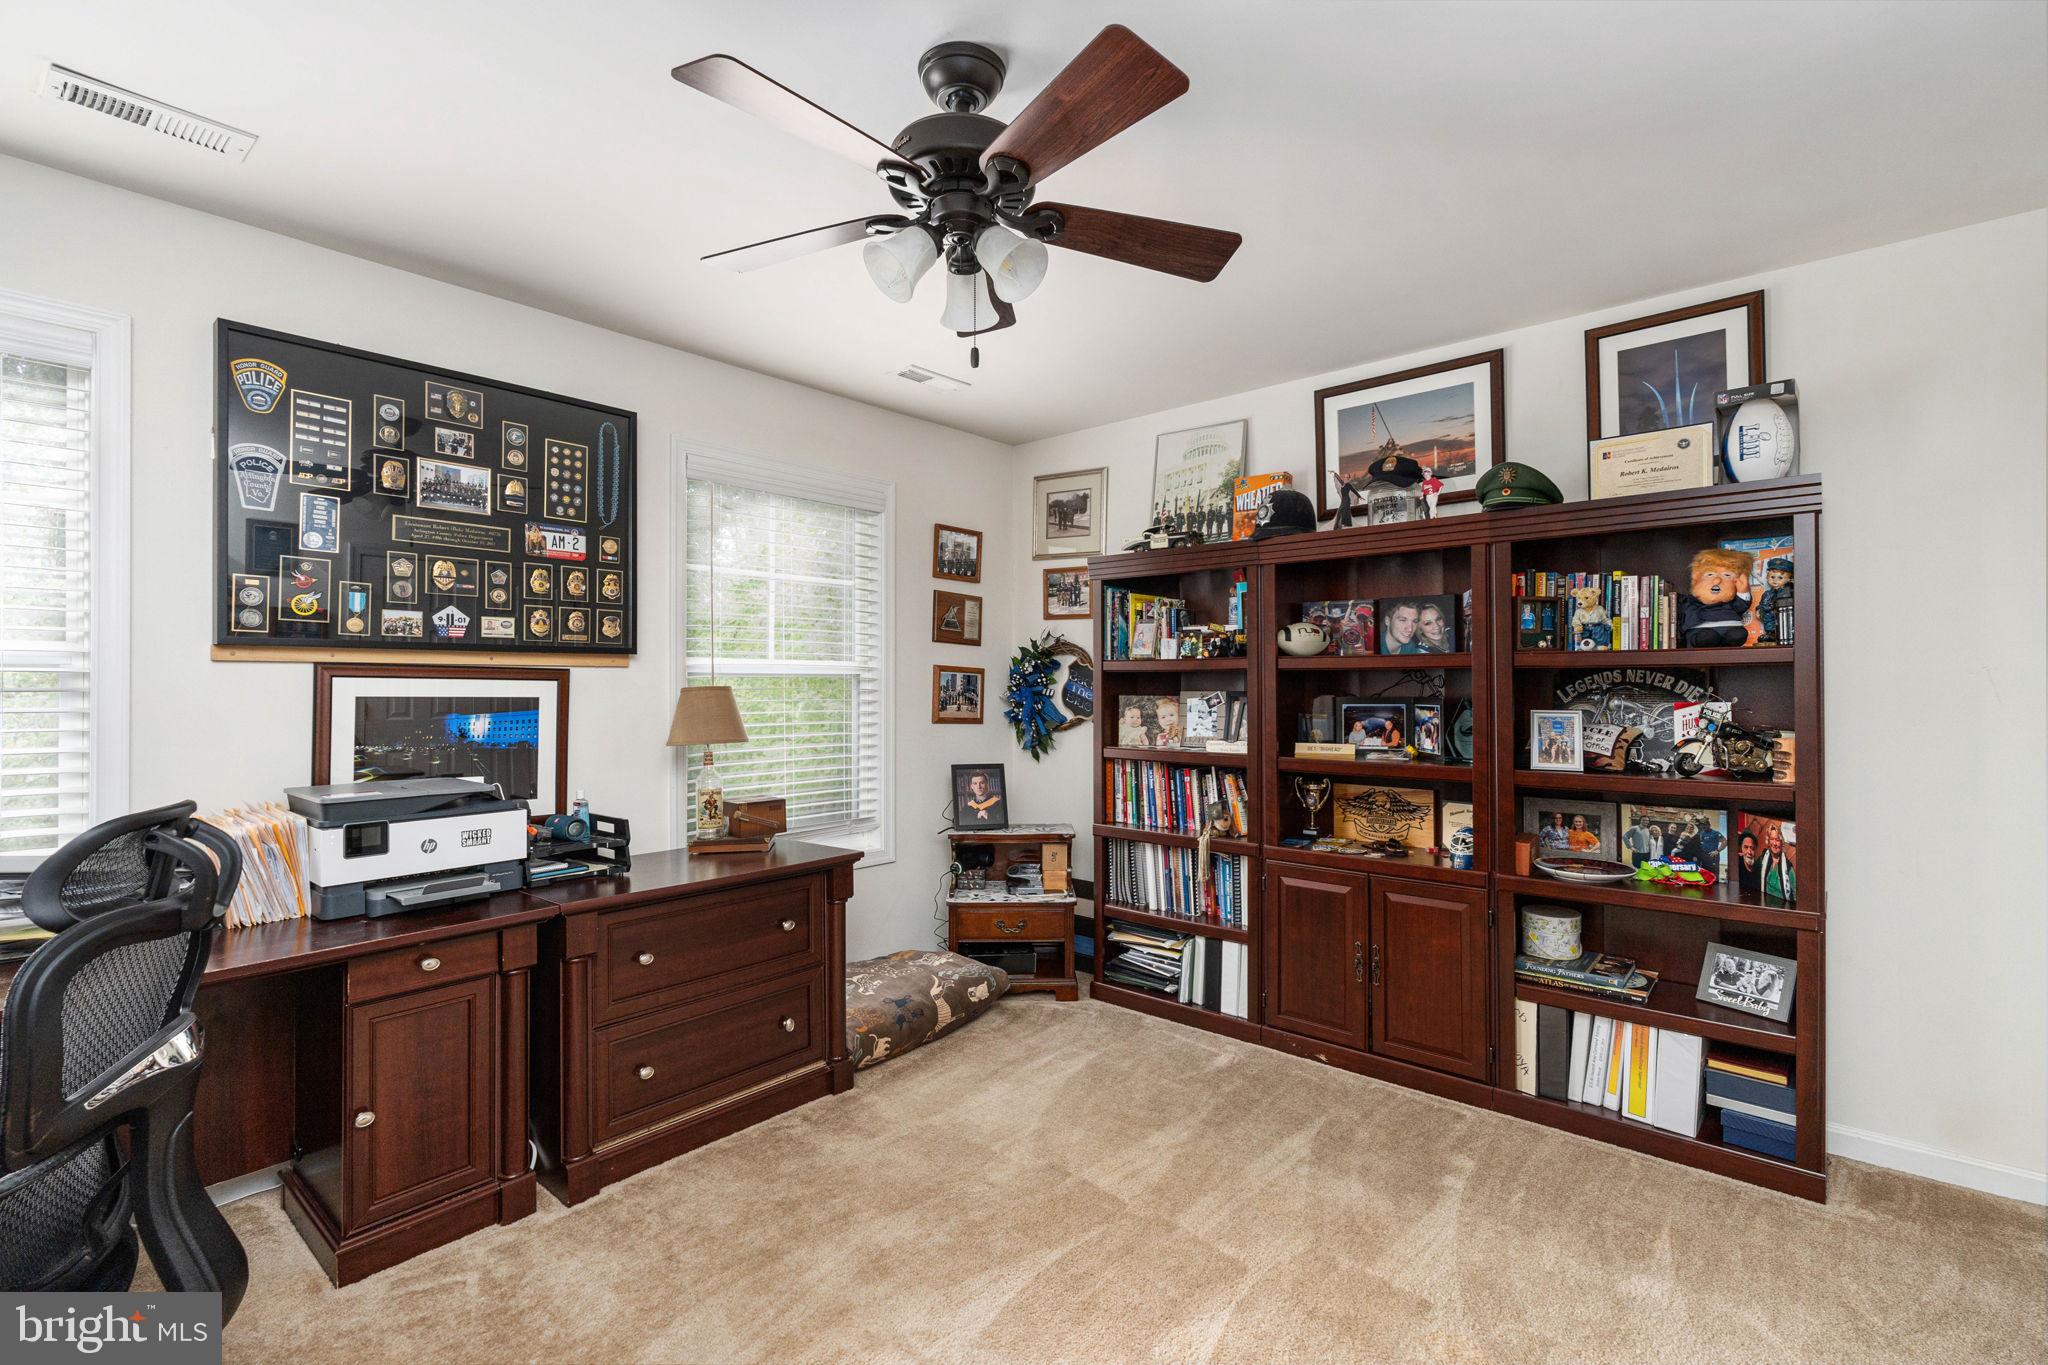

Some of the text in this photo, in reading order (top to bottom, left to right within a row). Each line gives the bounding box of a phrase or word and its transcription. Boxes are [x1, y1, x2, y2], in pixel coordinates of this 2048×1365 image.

[260, 363, 283, 377] GUARD
[237, 371, 282, 392] POLICE
[240, 459, 275, 472] POLICE
[1620, 469, 1640, 477] Robert
[1557, 669, 1704, 703] LEGENDS NEVER DIE
[1585, 742, 1610, 752] Office
[461, 829, 491, 839] WICKED
[421, 838, 437, 853] hp
[1556, 968, 1585, 979] FATHERS
[1538, 977, 1564, 988] ATLAS
[1712, 989, 1771, 1016] Sweet Baby
